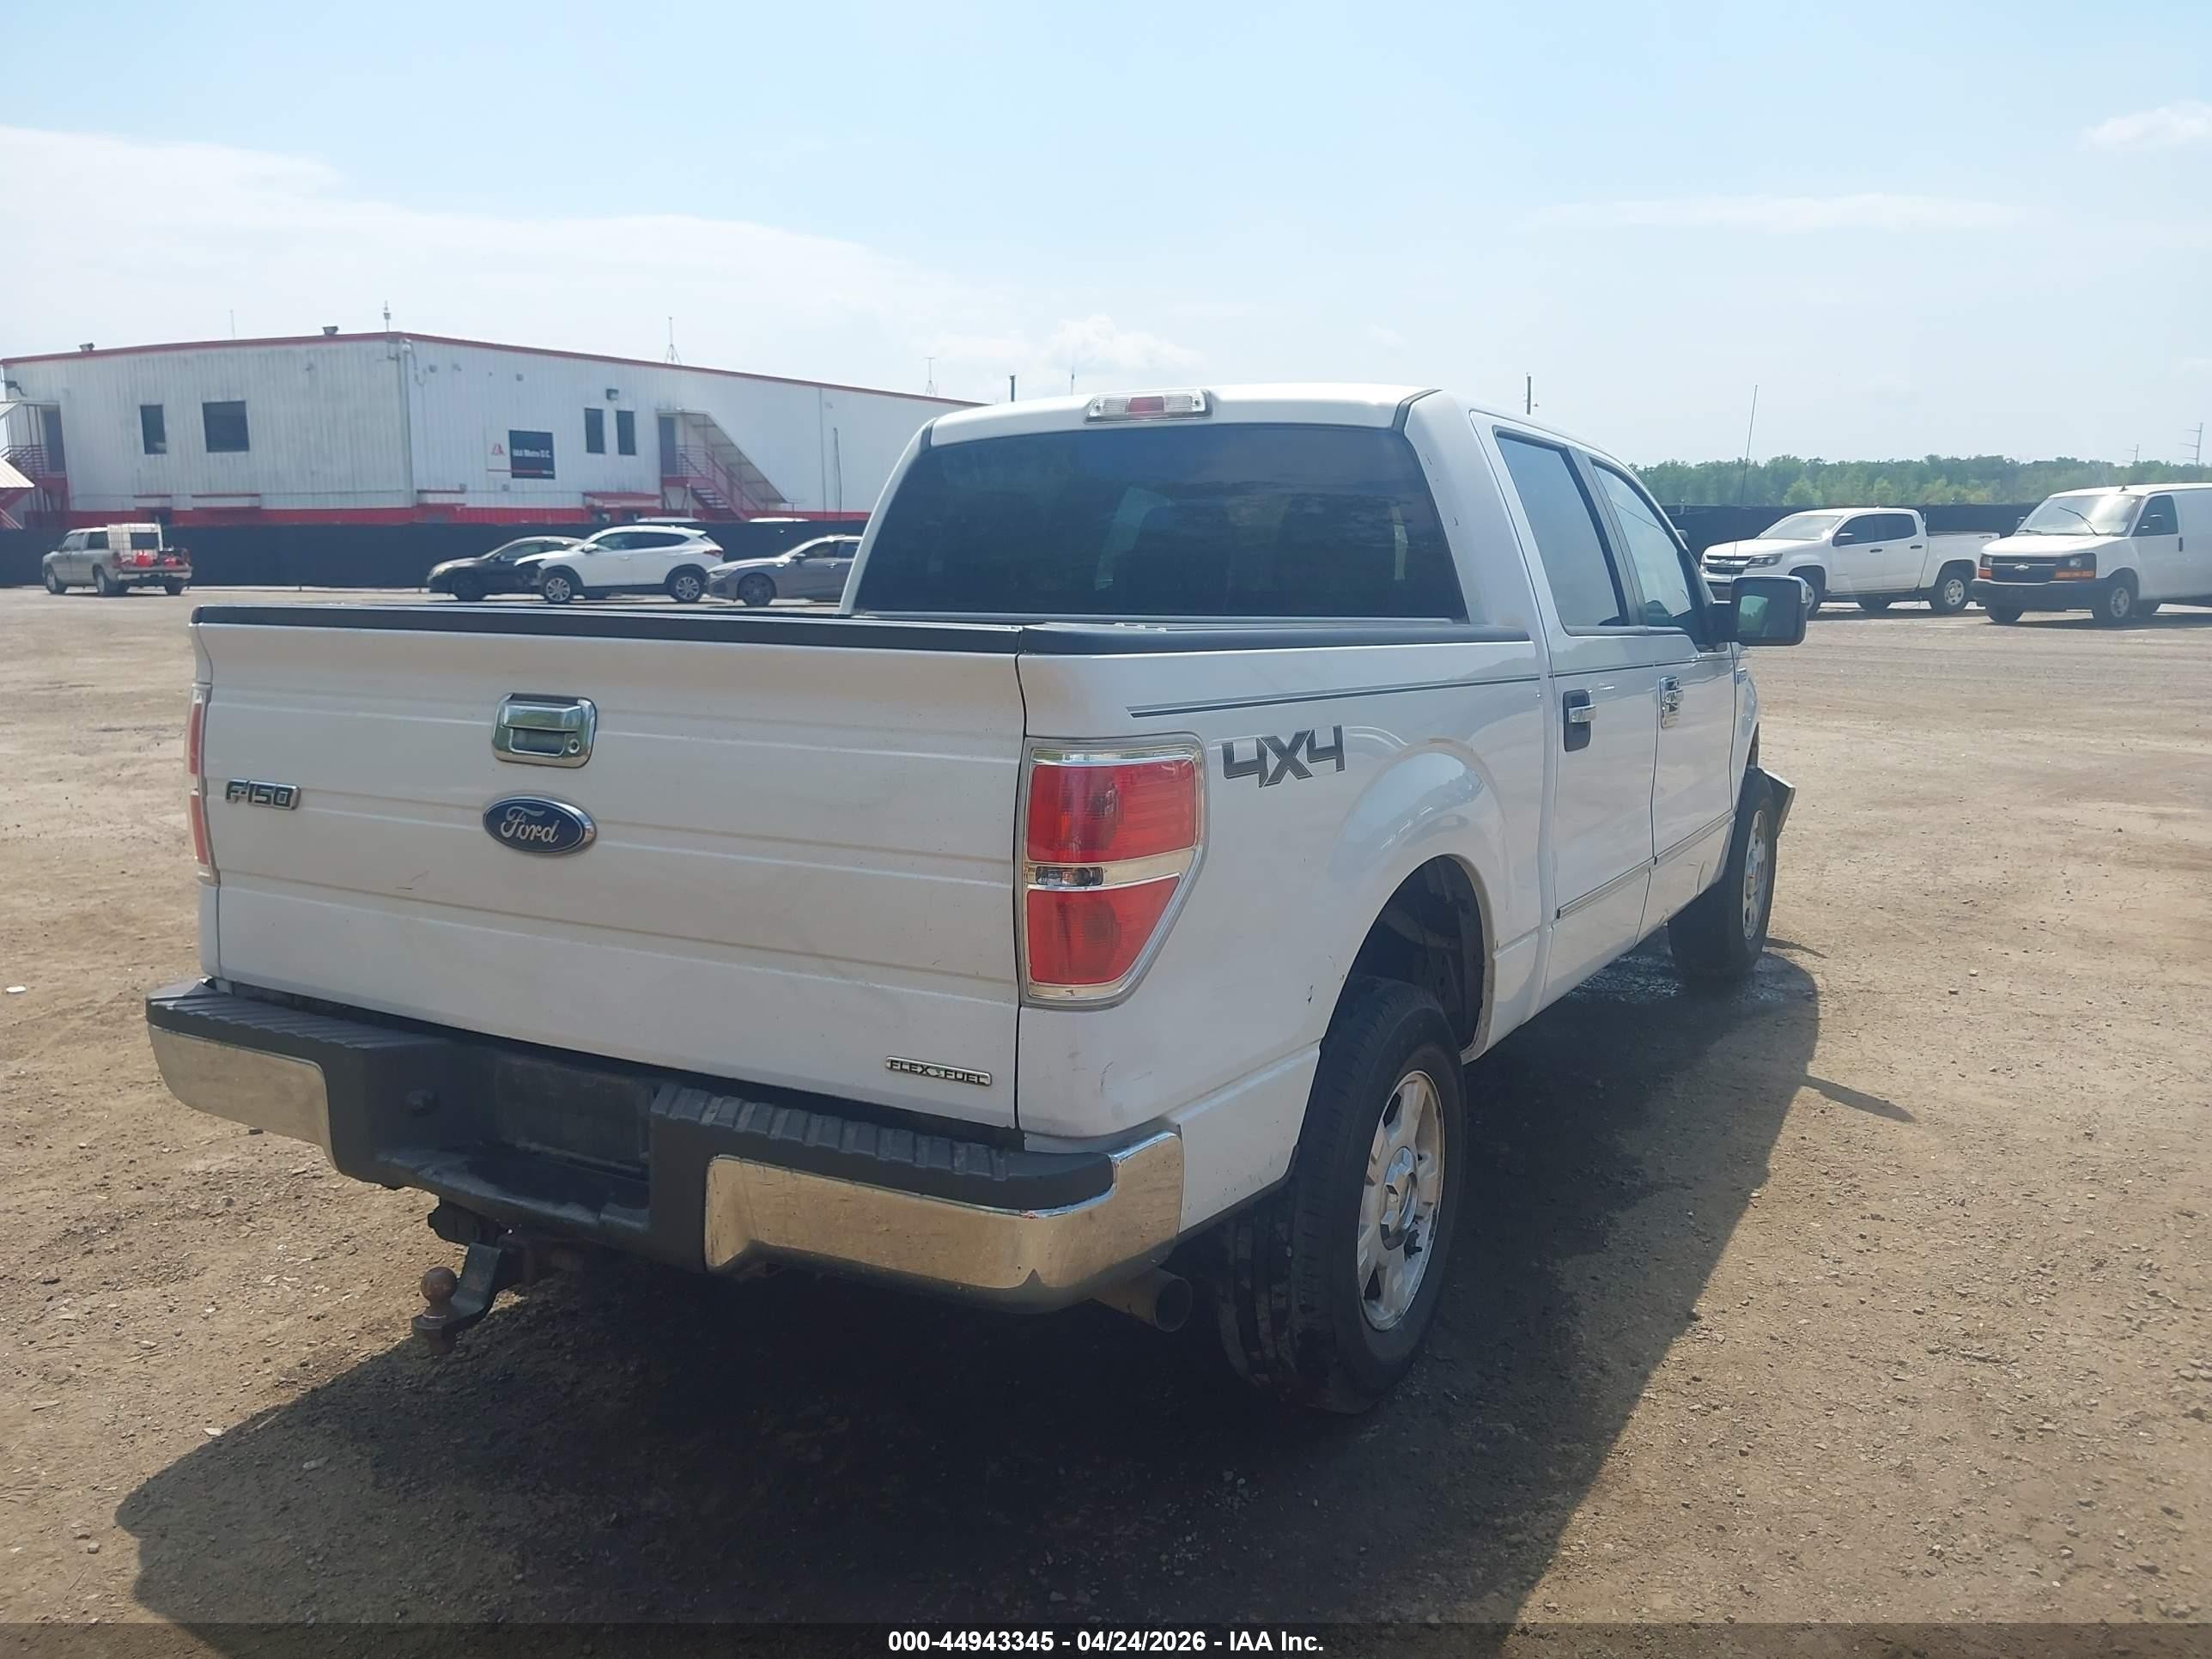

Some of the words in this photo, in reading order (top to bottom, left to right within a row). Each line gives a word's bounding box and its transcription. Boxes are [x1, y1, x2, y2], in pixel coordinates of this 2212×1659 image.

[500, 805, 562, 843] Ford
[889, 1058, 930, 1076] FLEX
[944, 1068, 988, 1085] FUEL
